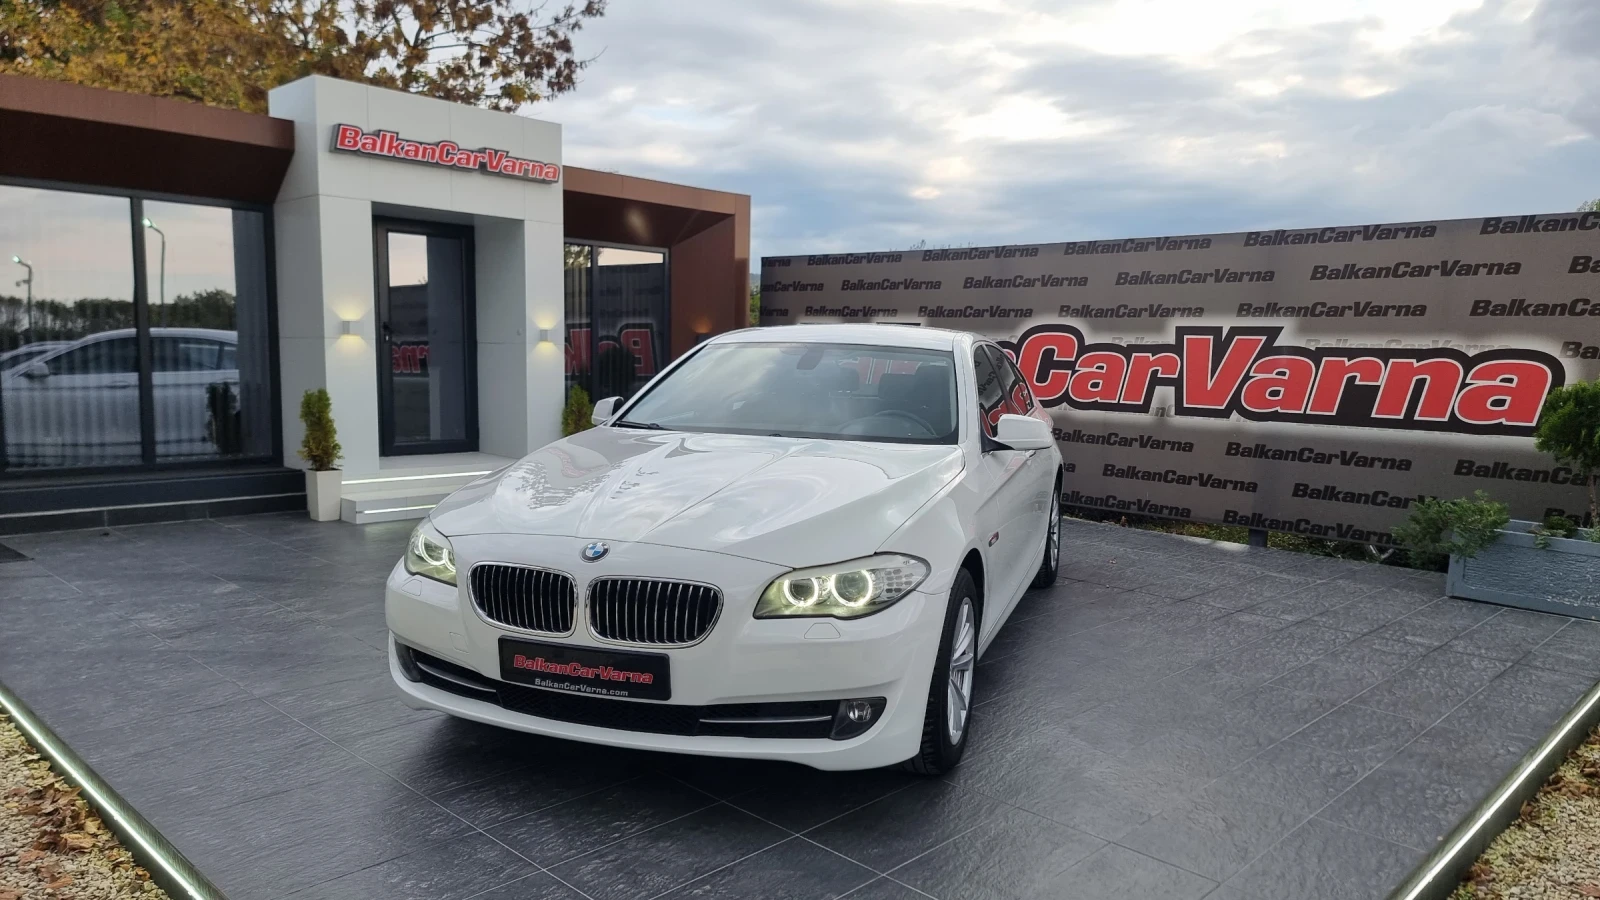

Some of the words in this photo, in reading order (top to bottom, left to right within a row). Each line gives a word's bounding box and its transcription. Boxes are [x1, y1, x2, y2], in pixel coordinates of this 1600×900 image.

[337, 125, 559, 181] BalkanCarVarna
[1243, 224, 1437, 247] BalkanCarVarna
[921, 246, 1039, 262] BalkanCarVarna
[1063, 236, 1212, 256] BalkanCarVarna
[807, 253, 902, 266] BalkanCarVarna
[1115, 268, 1275, 286] BalkanCarVarna
[1310, 260, 1522, 281] BalkanCarVarna
[840, 278, 941, 291] BalkanCarVarna
[963, 274, 1088, 289] BalkanCarVarna
[804, 305, 898, 318] BalkanCarVarna
[917, 305, 1033, 318] BalkanCarVarna
[1058, 303, 1205, 319] BalkanCarVarna
[1236, 301, 1427, 318] BalkanCarVarna
[1003, 331, 1553, 428] CarVarna
[1053, 428, 1195, 452] BalkanCarVarna
[1225, 442, 1413, 471] BalkanCarVarna
[1102, 463, 1259, 493] BalkanCarVarna
[1061, 490, 1192, 518] alkanCarVarna
[513, 654, 653, 684] BalkanCarVarna
[534, 678, 629, 697] BalkanCarVarna.com
